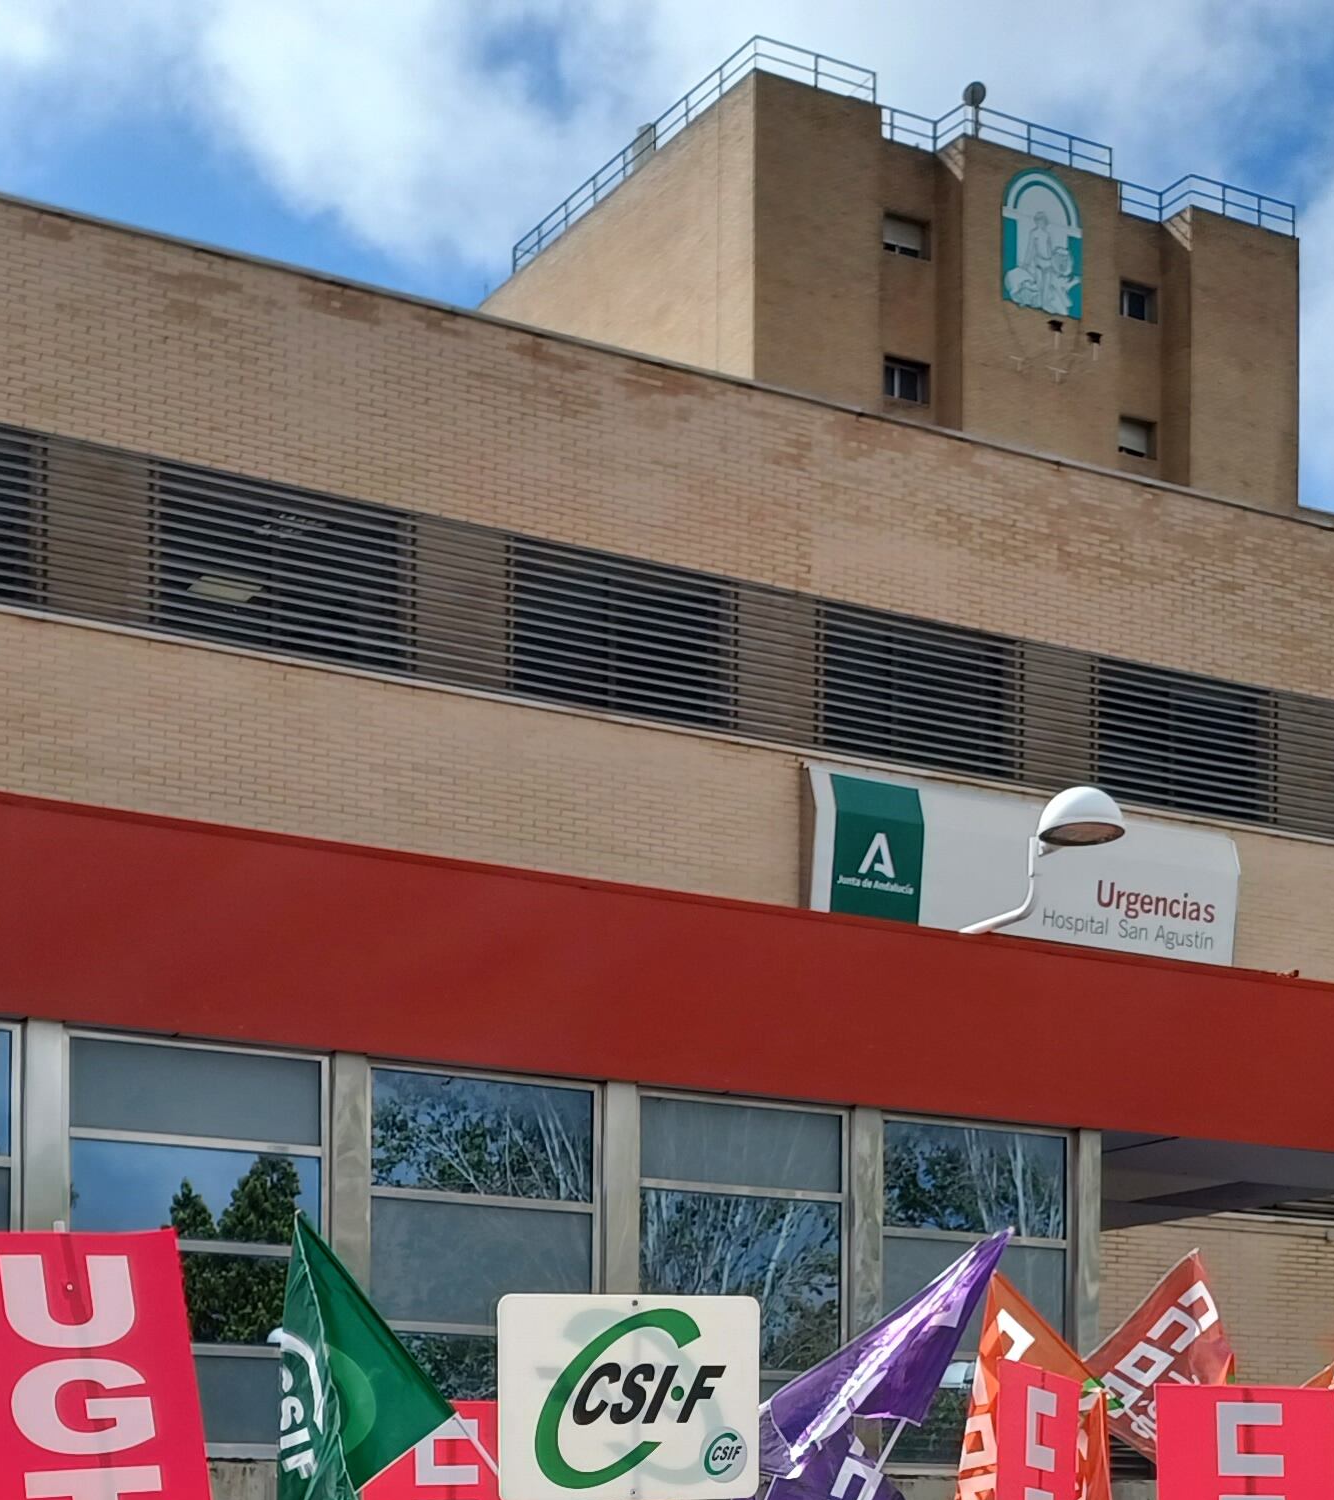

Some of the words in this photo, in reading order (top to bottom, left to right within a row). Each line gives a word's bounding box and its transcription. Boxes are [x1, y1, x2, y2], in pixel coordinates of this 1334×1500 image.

[837, 874, 861, 887] Junta
[861, 878, 873, 888] de
[1097, 879, 1215, 923] Urgencias
[1042, 907, 1109, 936] Hospital
[1118, 919, 1148, 942] San
[1154, 924, 1214, 951] Agustín
[711, 1445, 743, 1462] CSIF
